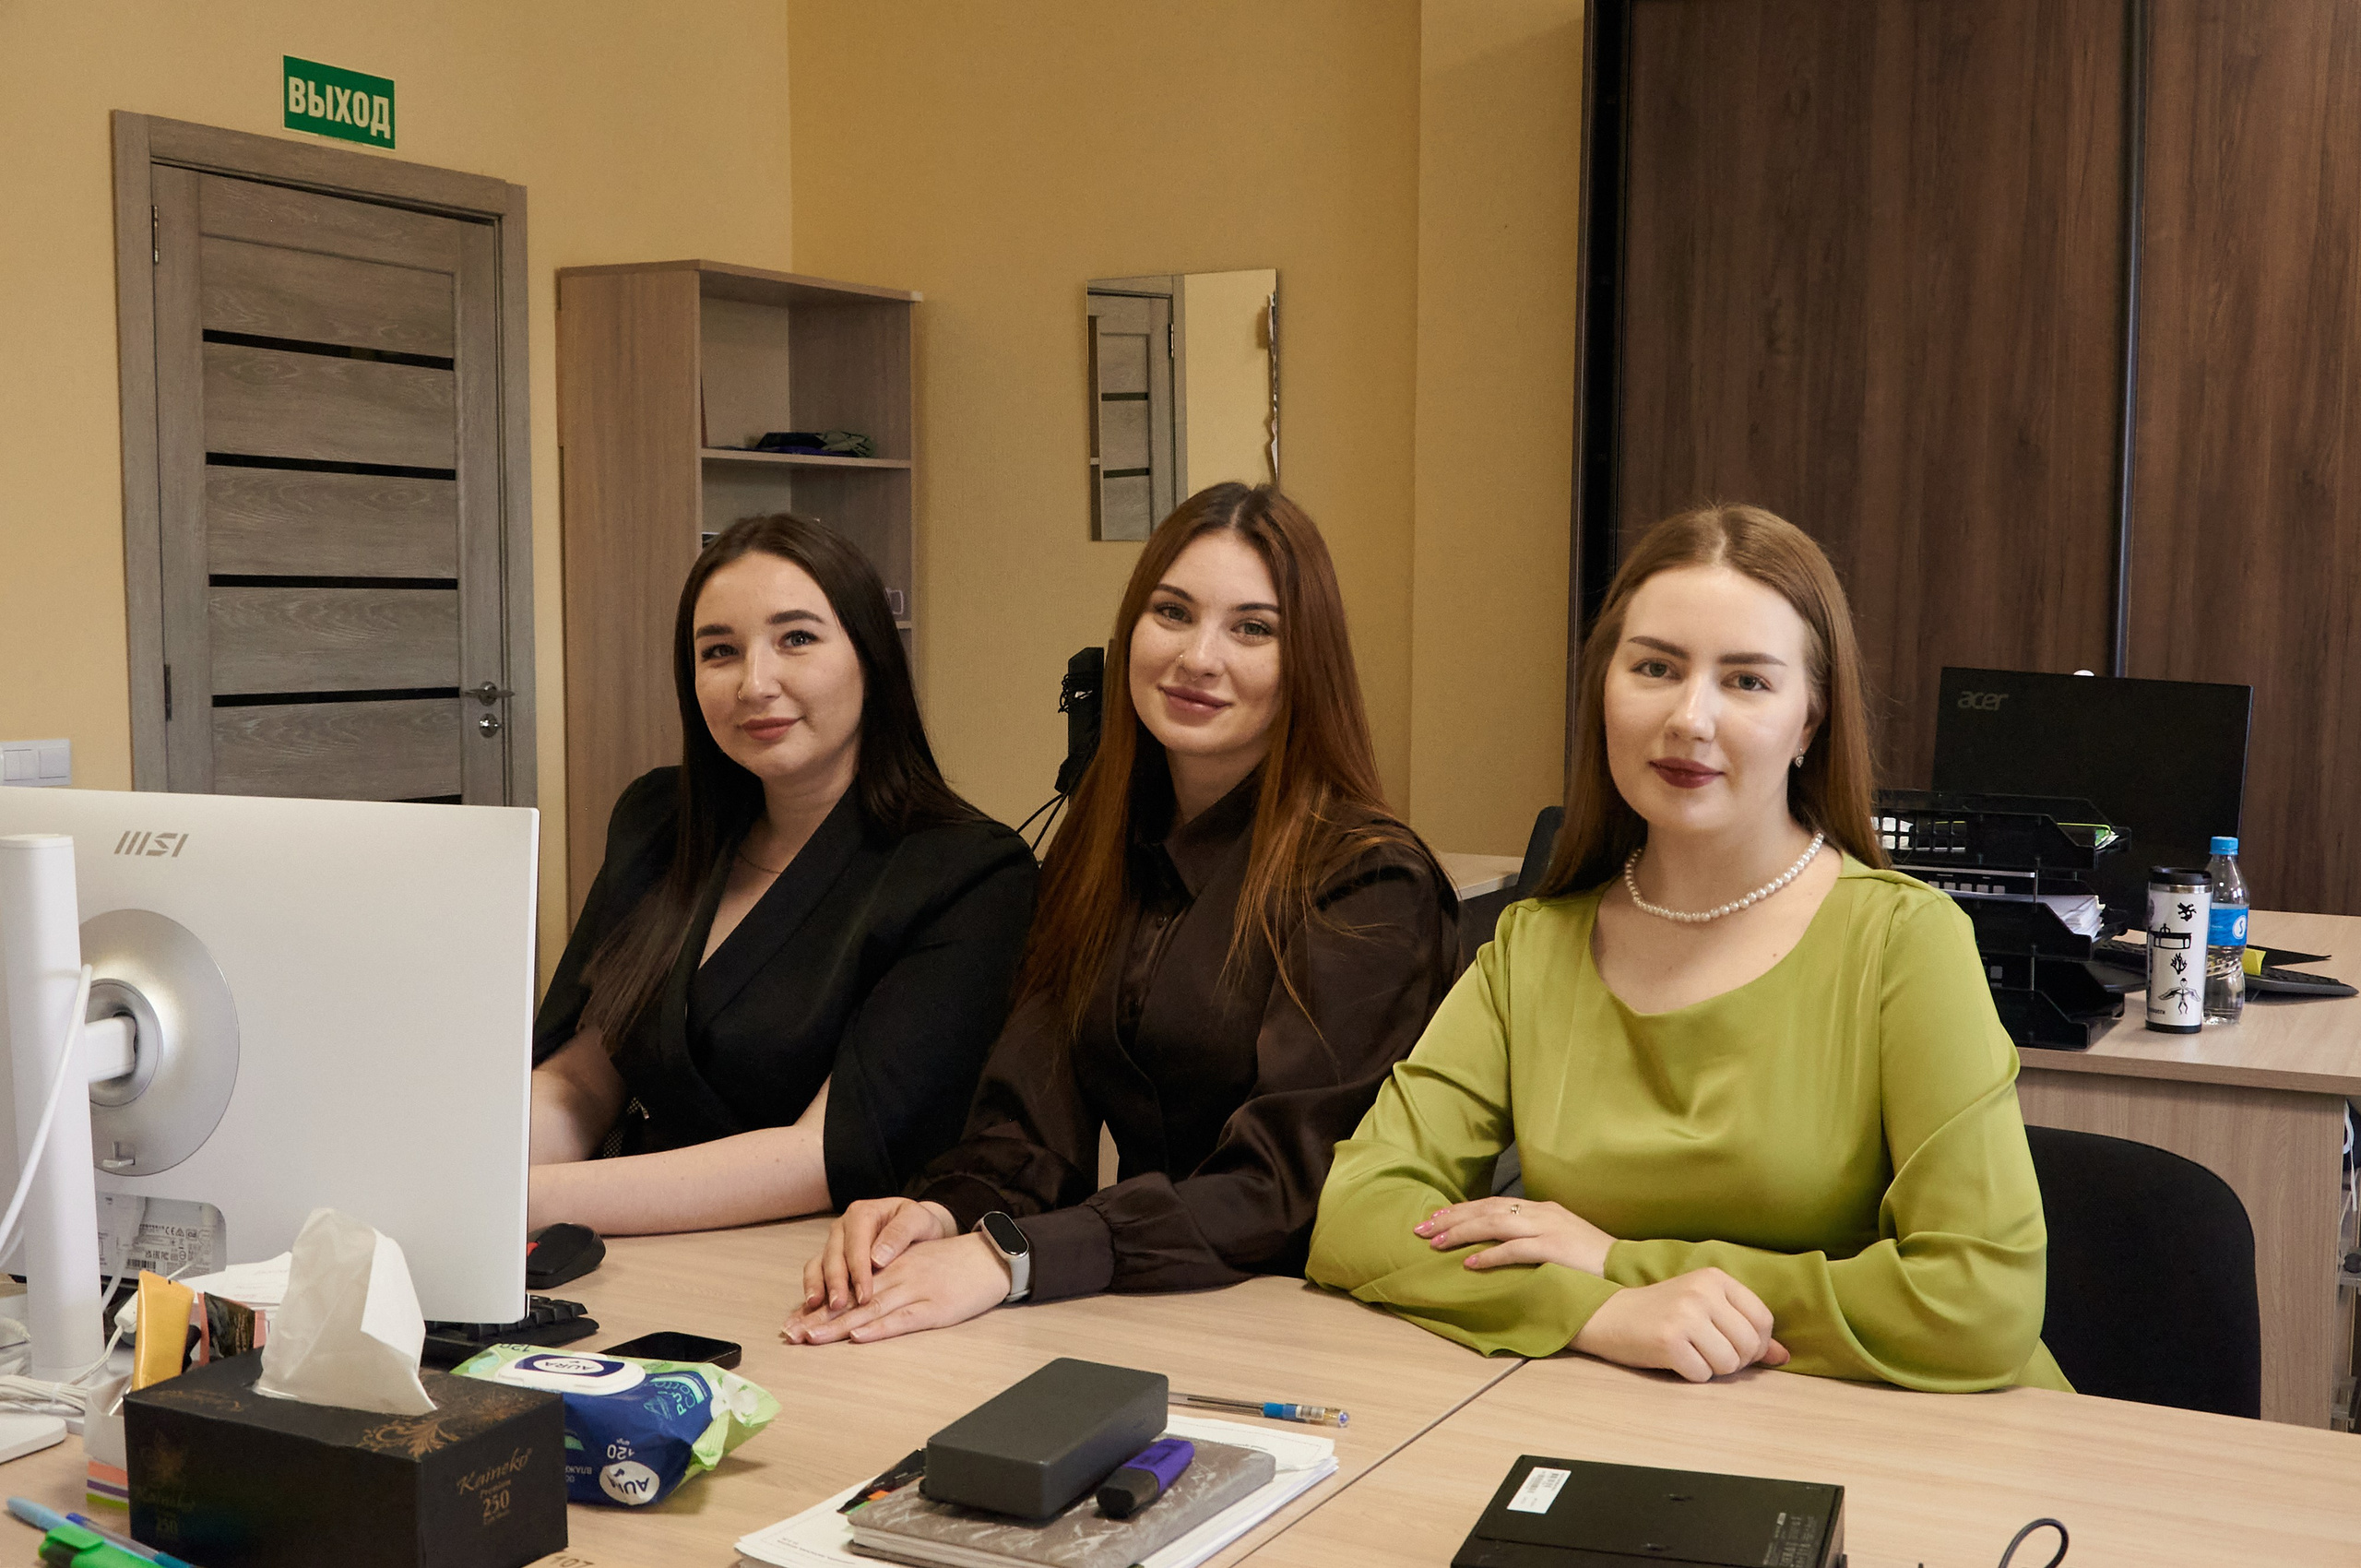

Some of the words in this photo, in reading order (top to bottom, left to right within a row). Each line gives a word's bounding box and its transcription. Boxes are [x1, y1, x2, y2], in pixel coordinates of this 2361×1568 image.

[288, 76, 391, 139] ВЫХОД
[1957, 691, 2010, 711] acer
[544, 1361, 596, 1372] AURA
[607, 1444, 635, 1460] 120
[482, 1489, 511, 1518] 250
